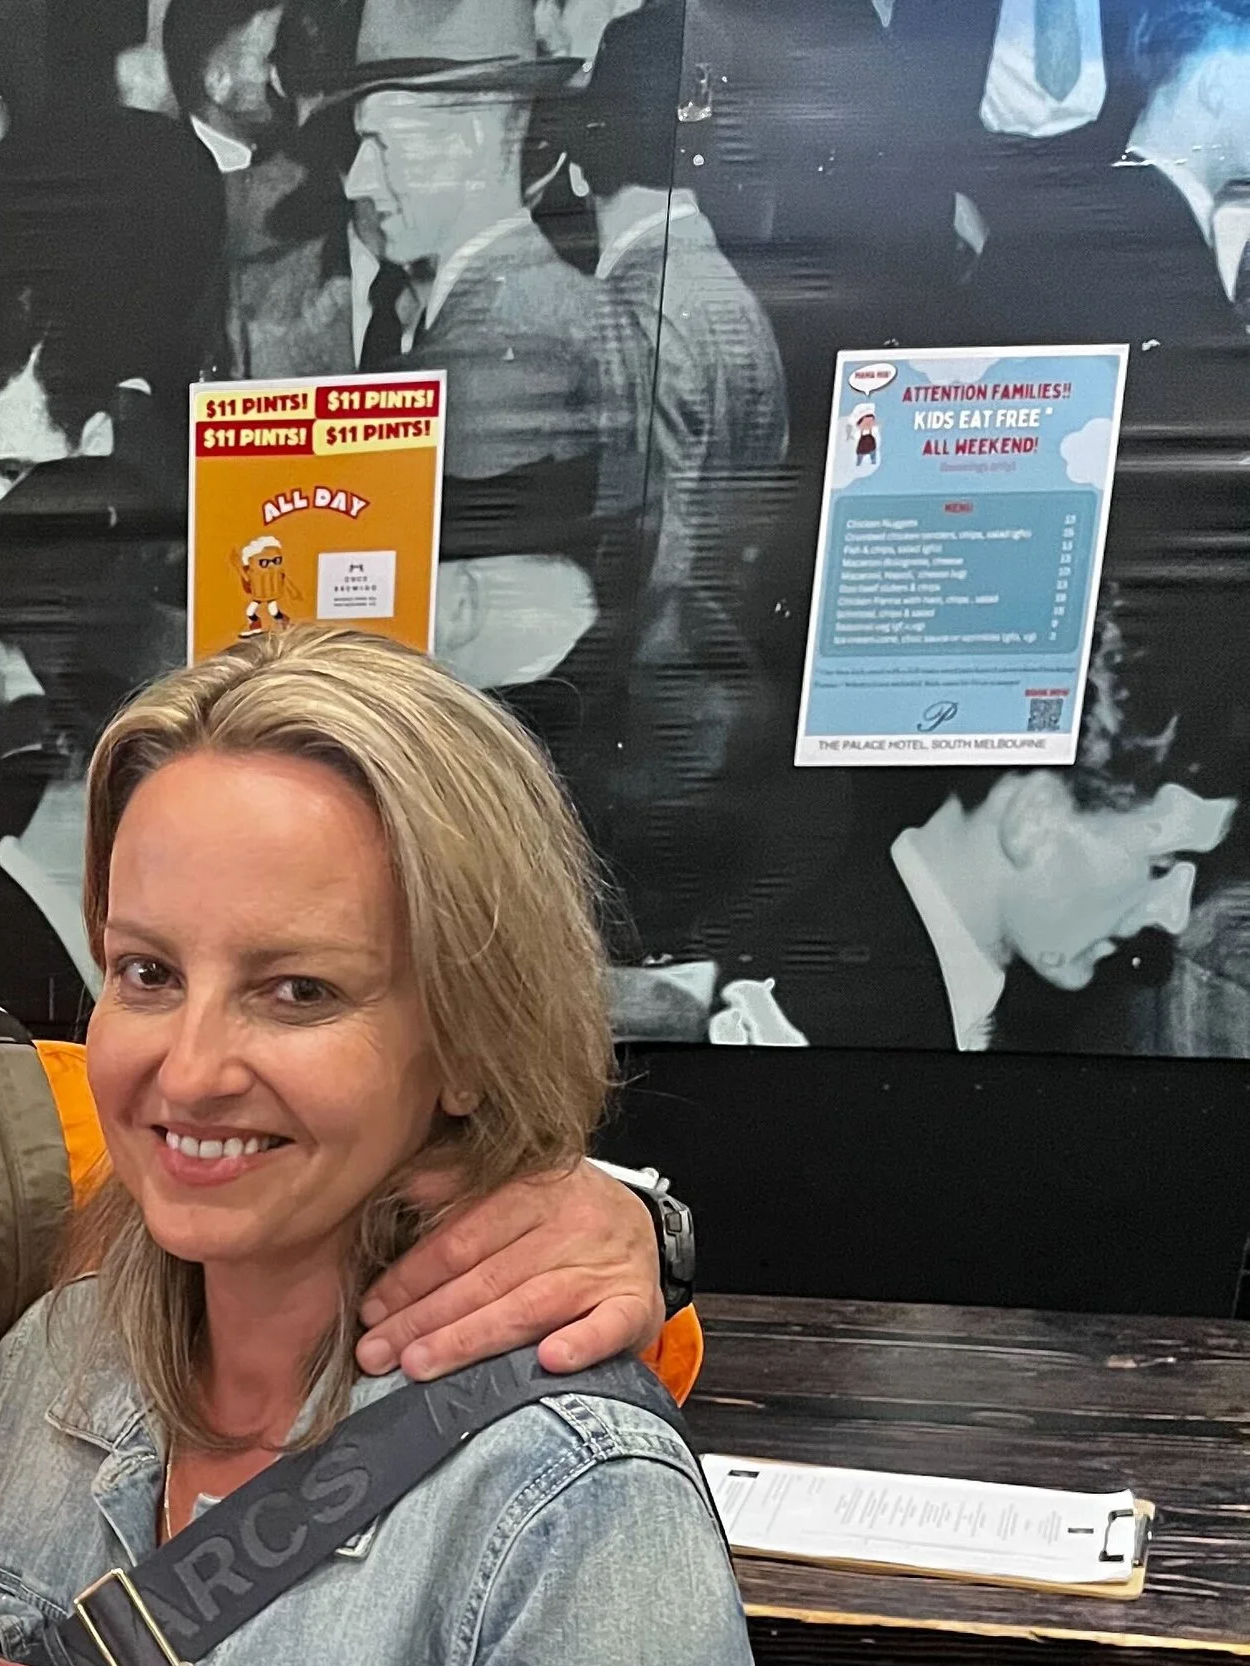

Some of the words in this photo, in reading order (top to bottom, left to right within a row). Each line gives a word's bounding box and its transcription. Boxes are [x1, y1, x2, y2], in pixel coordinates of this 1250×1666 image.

[327, 390, 359, 412] $11
[362, 389, 435, 410] PINTS!
[902, 385, 988, 402] ATTENTION
[992, 382, 1072, 400] FAMILIES!!
[206, 399, 236, 419] $11
[242, 393, 309, 415] PINTS!
[914, 411, 954, 430] KIDS
[959, 411, 991, 429] EAT
[995, 408, 1040, 428] FREE
[203, 428, 236, 449] $11
[239, 427, 307, 447] PINTS!
[326, 425, 357, 445] $11
[362, 420, 431, 442] PINTS!
[922, 439, 950, 456] ALL
[955, 437, 1039, 455] WEEKEND!
[262, 488, 309, 526] ALL
[313, 486, 370, 519] DAY
[818, 740, 839, 751] THE
[842, 740, 885, 751] PALACE
[931, 739, 972, 750] SOUTH
[974, 739, 1046, 750] MELBOURNE
